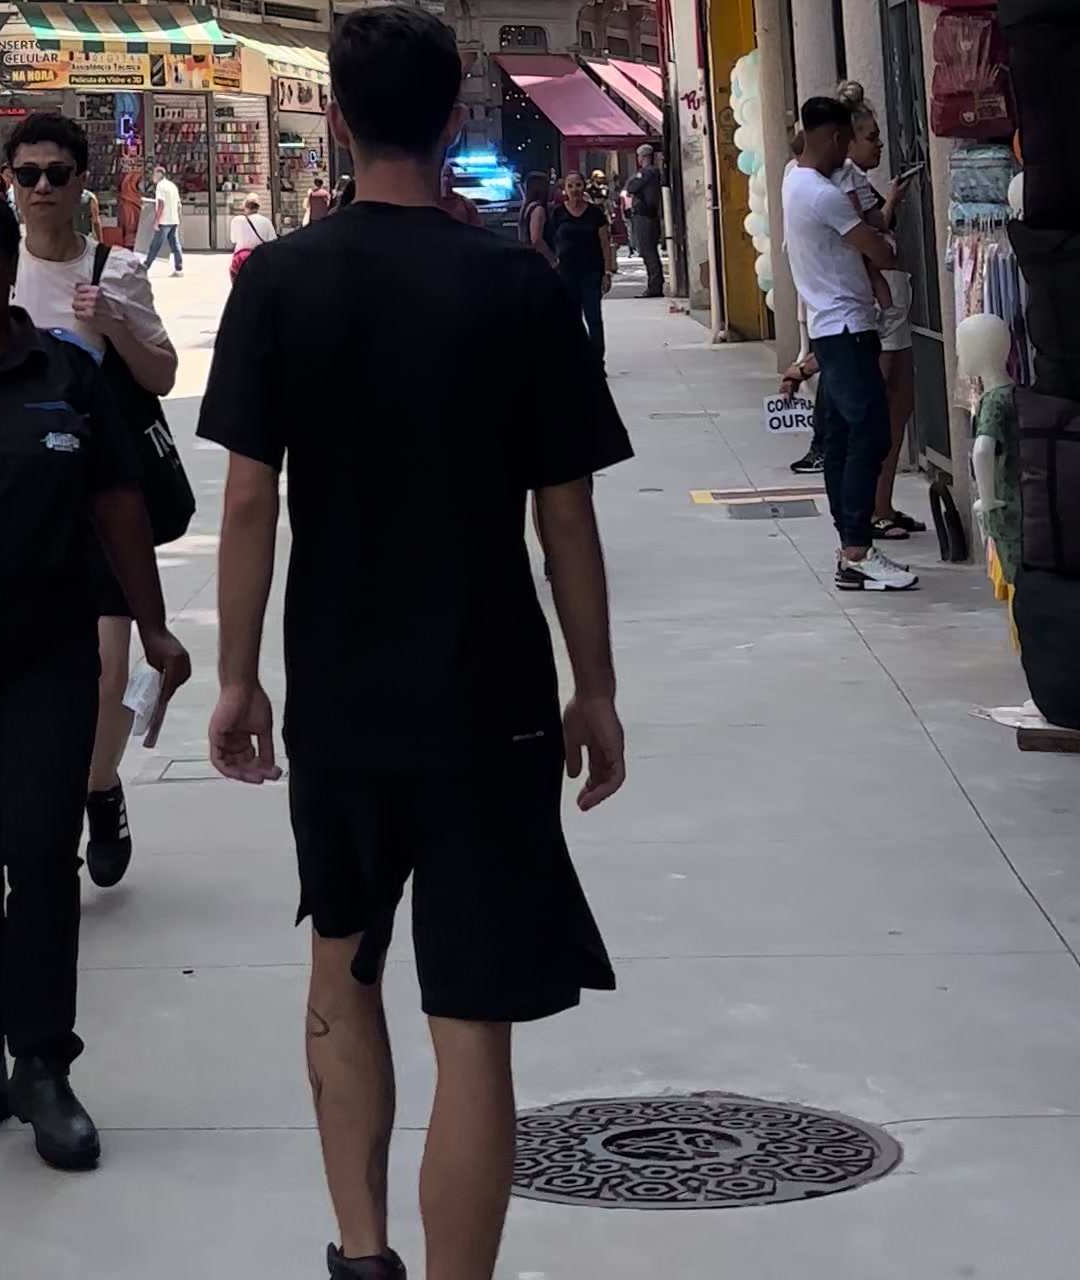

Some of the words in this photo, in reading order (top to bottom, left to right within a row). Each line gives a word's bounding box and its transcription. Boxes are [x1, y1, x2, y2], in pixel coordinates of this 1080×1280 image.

[5, 53, 58, 64] CELULAR
[12, 70, 26, 81] NA
[27, 70, 55, 81] HORA
[769, 414, 815, 430] OURO
